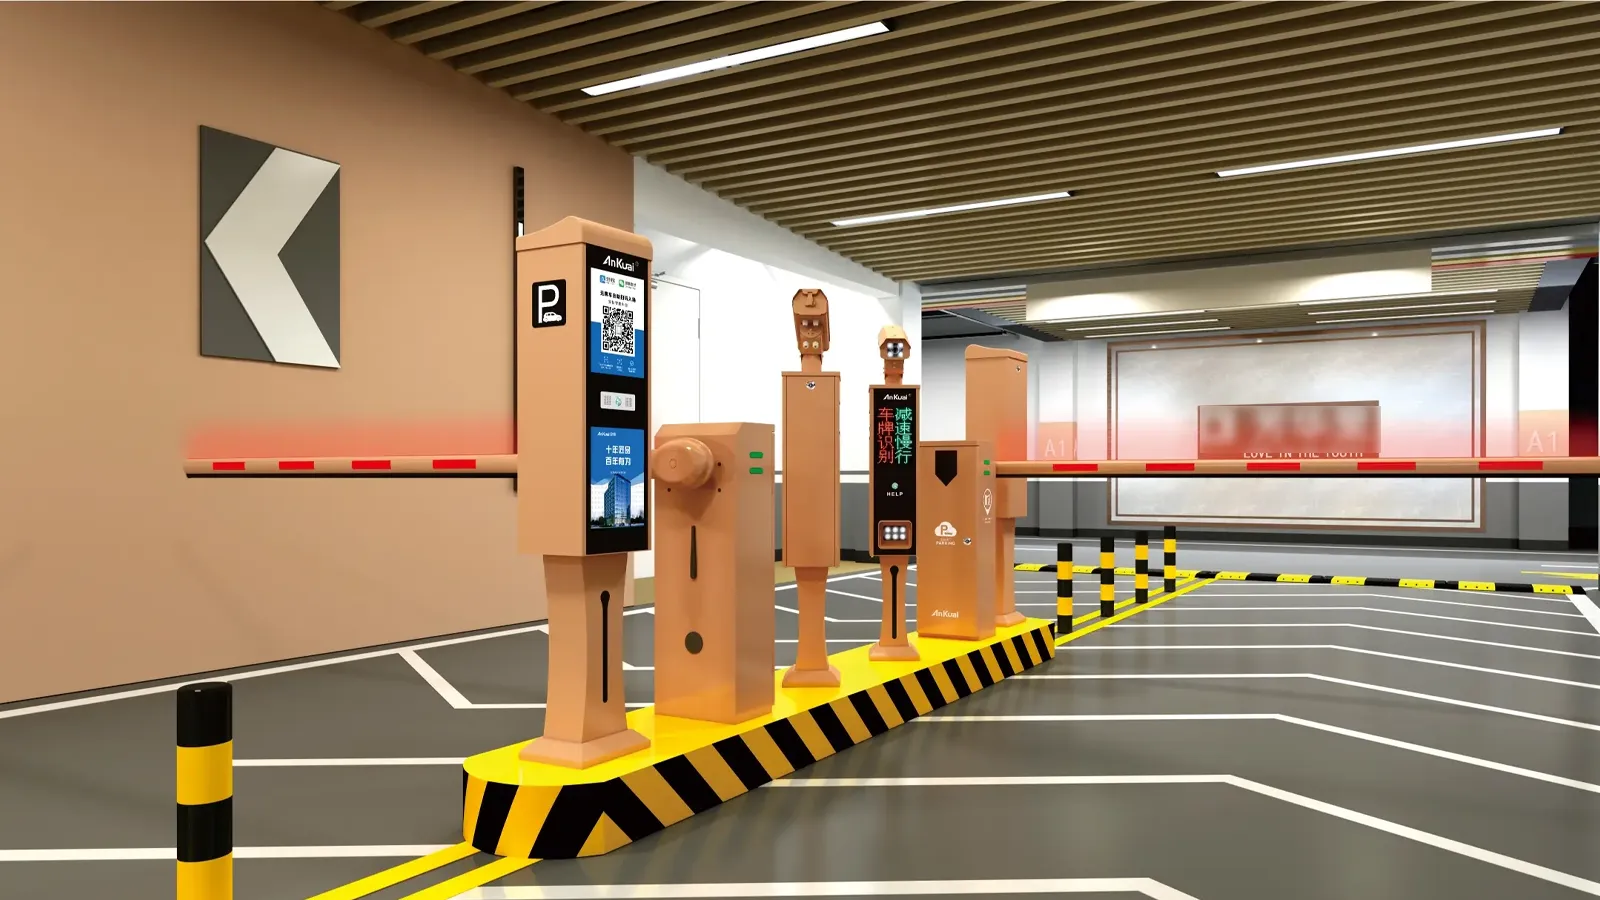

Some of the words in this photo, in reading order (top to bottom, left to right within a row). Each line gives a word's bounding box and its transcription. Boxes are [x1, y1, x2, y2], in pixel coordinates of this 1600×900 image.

[538, 284, 560, 324] P
[877, 406, 894, 464] 车牌识别
[894, 406, 913, 464] 减速慢行
[1044, 438, 1065, 457] A1
[1526, 430, 1557, 453] A1
